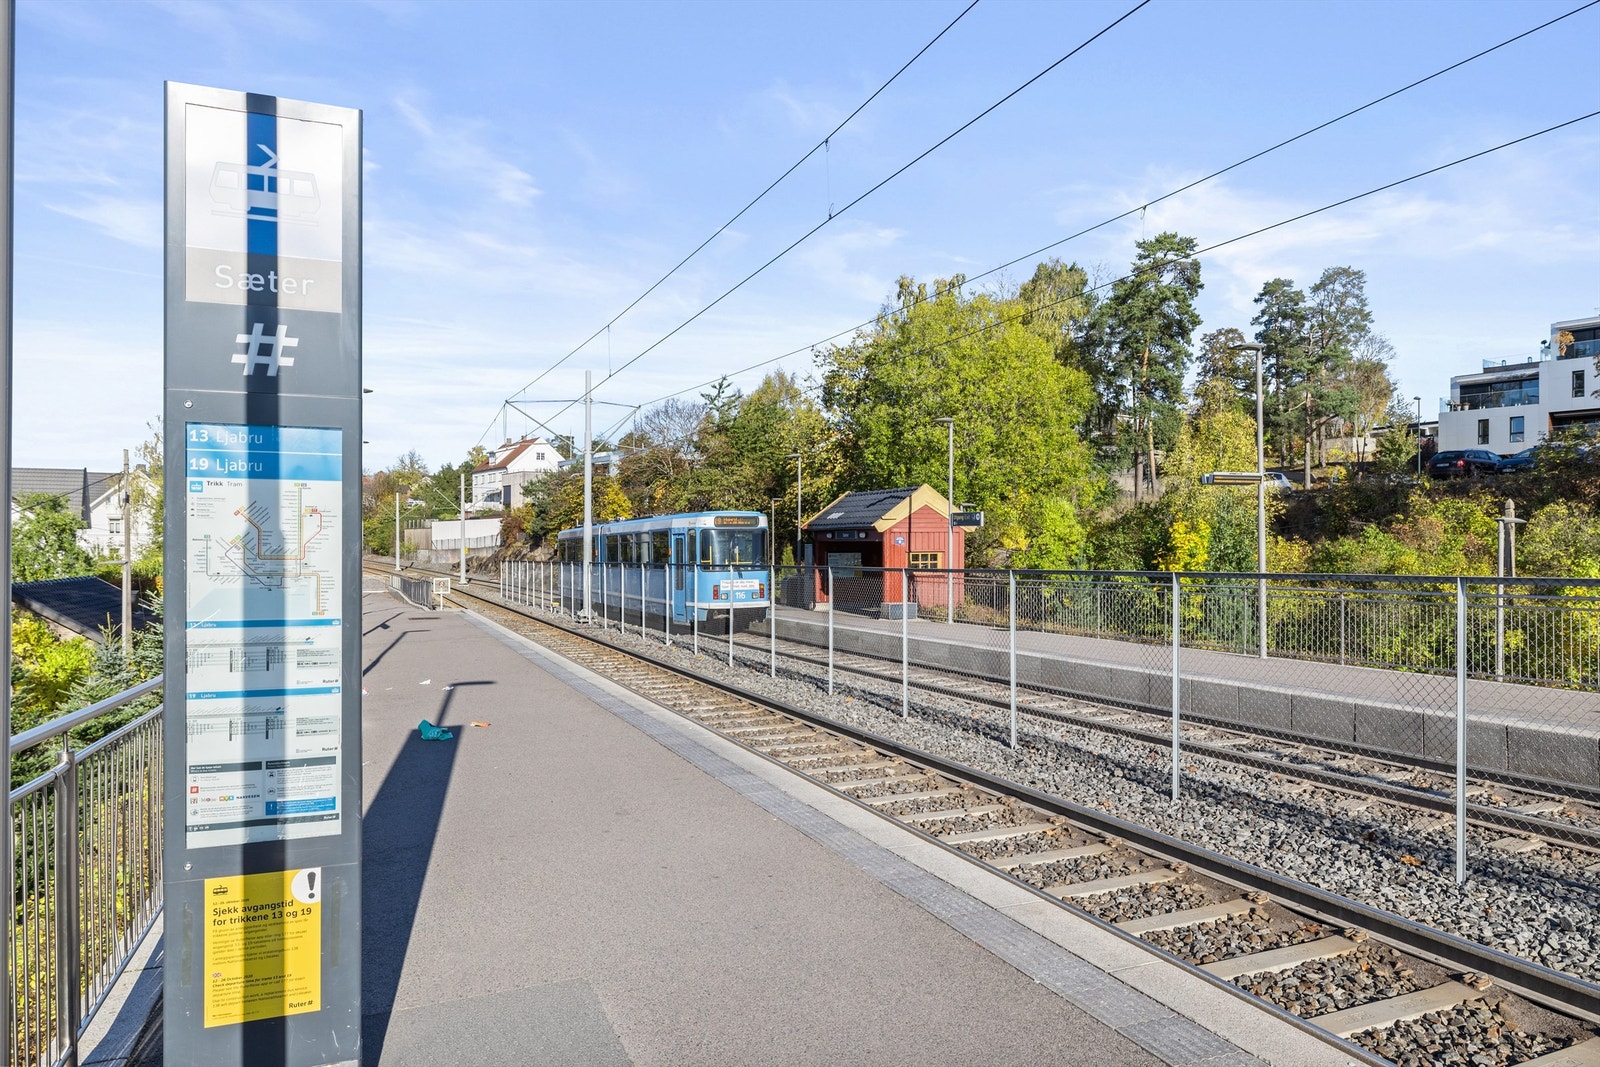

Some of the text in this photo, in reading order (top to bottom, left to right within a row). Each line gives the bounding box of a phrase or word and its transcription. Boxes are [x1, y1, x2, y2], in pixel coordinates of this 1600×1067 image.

[215, 264, 315, 296] Sæter
[190, 430, 263, 446] 13 Ljabru
[190, 457, 263, 473] 19 Ljabru
[213, 900, 293, 917] Sjekk avgangstid
[213, 918, 227, 926] for
[230, 913, 268, 924] trikkene
[272, 911, 283, 919] 13
[301, 908, 312, 916] 19
